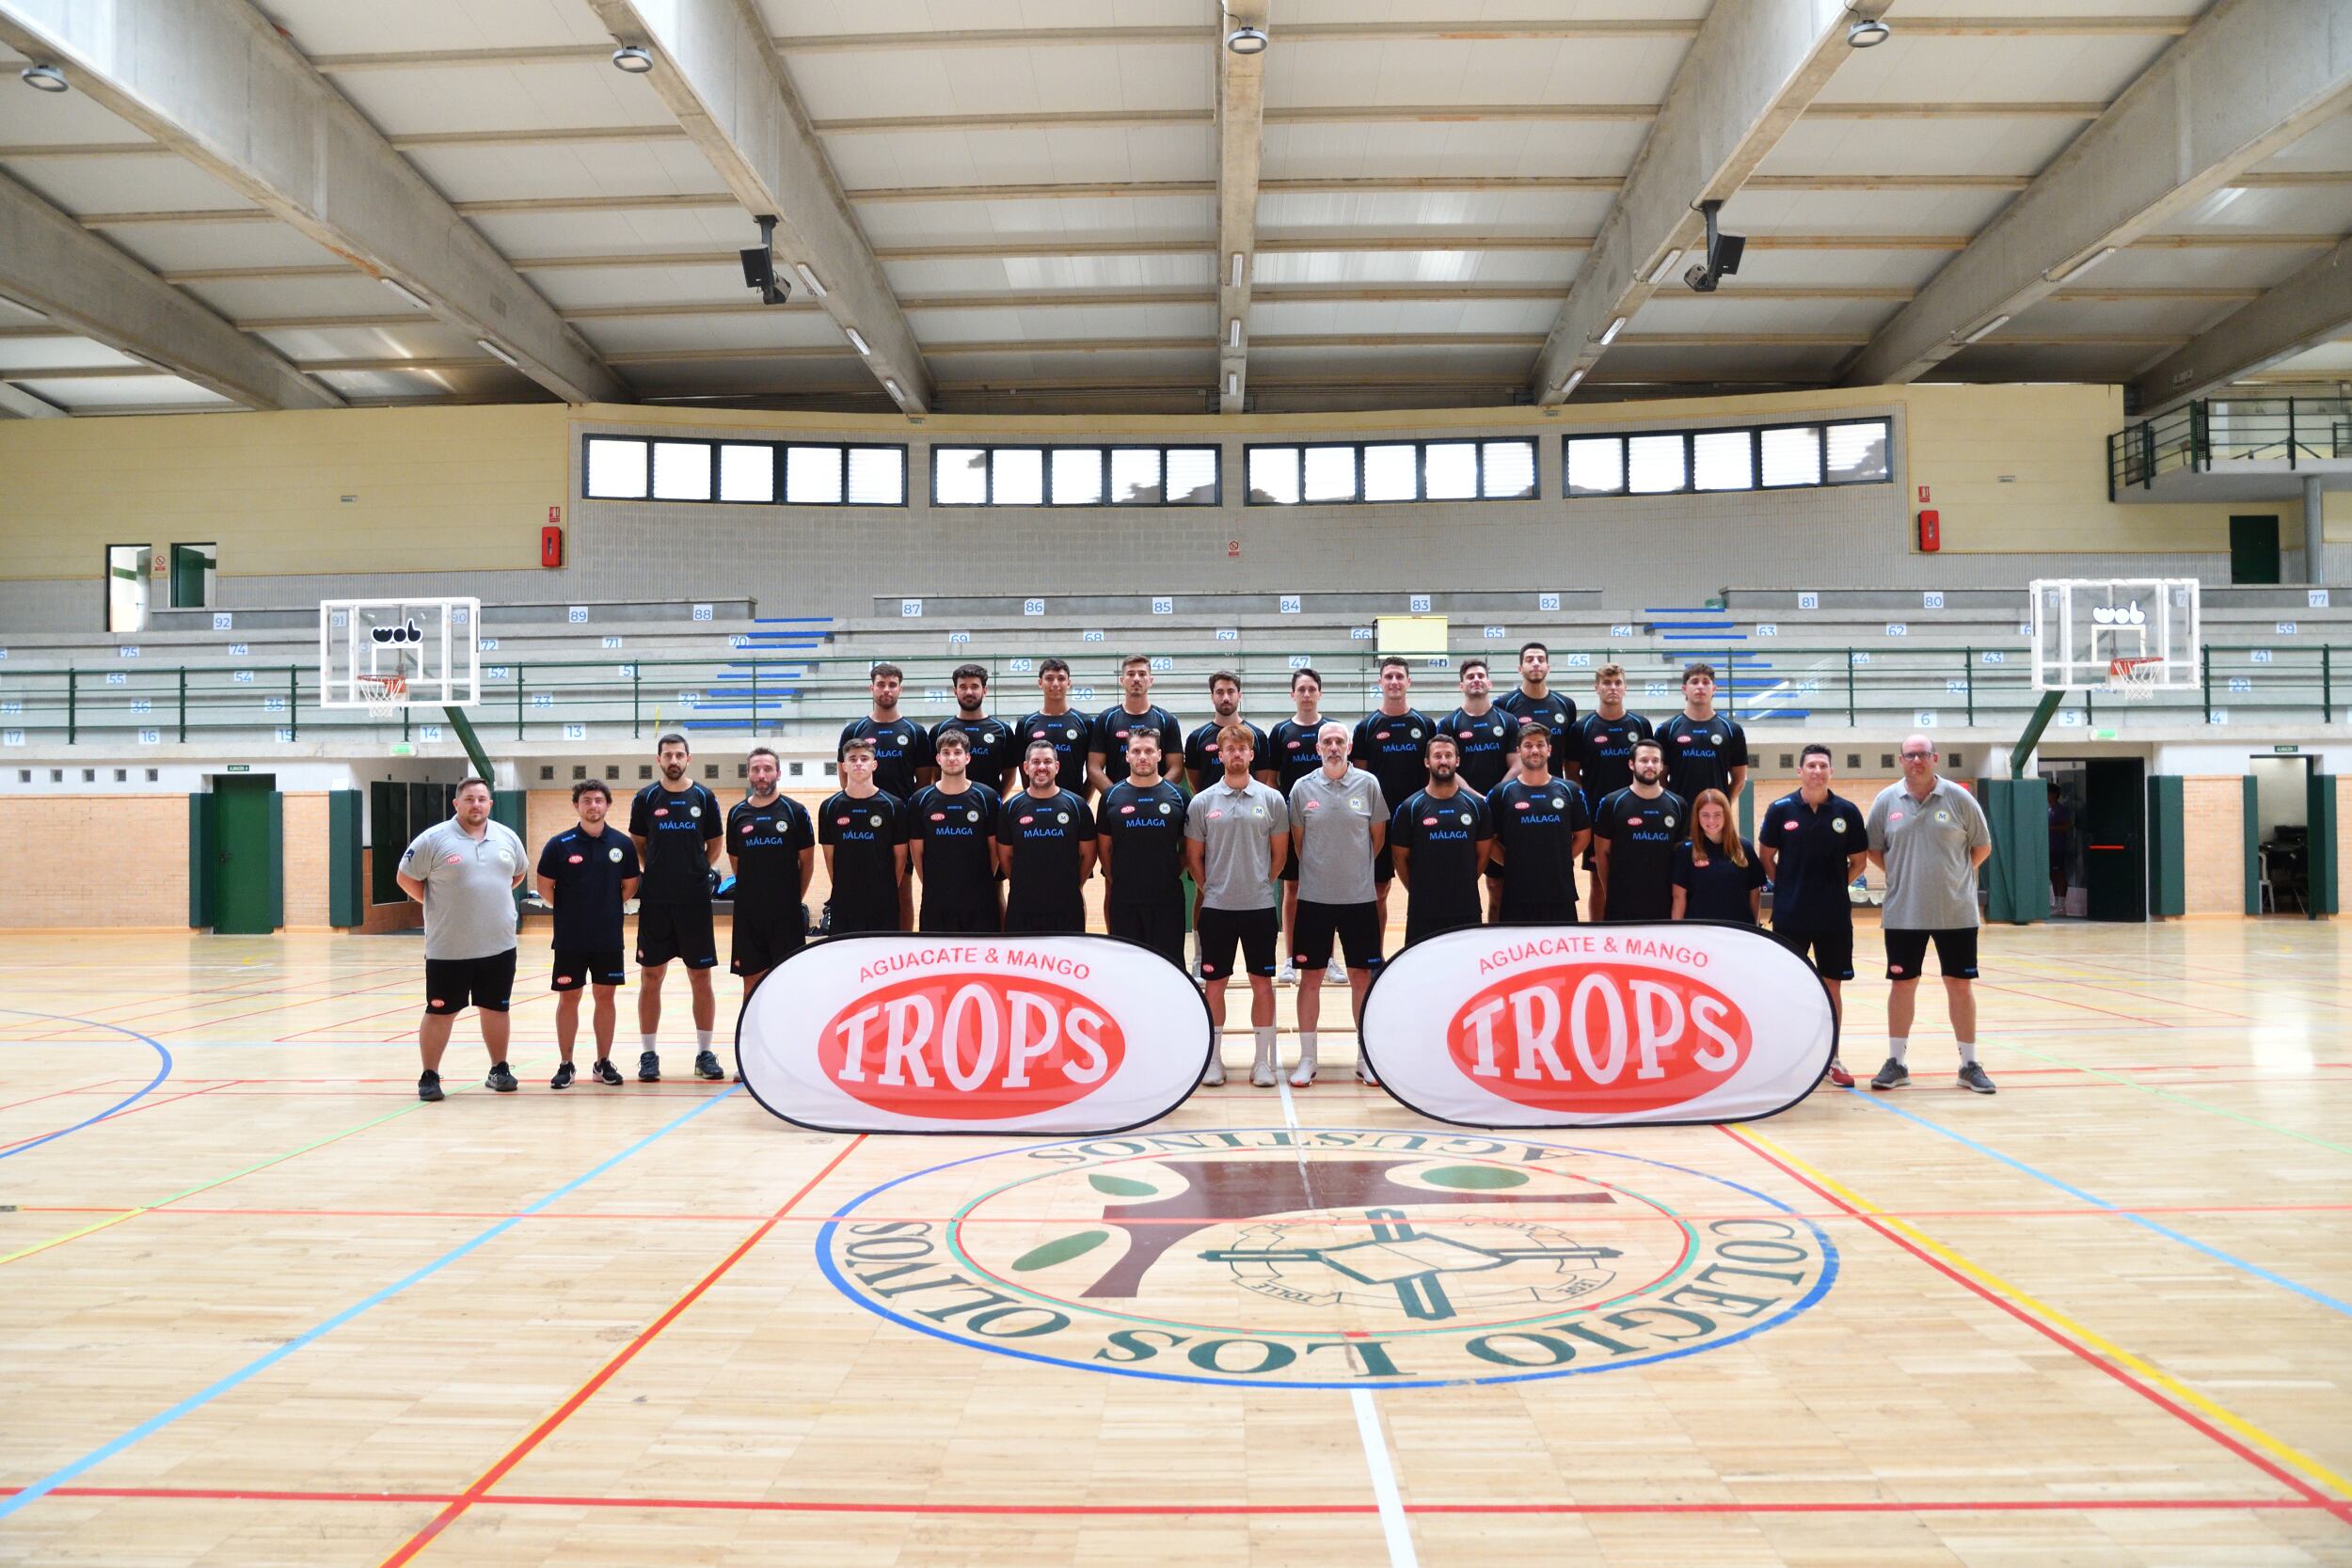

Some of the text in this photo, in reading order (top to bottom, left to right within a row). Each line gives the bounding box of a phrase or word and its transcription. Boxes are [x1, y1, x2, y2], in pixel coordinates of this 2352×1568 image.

[1542, 598, 1557, 609] 82
[1802, 597, 1815, 607] 81
[1925, 596, 1942, 607] 80
[2311, 594, 2327, 604] 77
[904, 604, 920, 614] 87
[1026, 602, 1043, 612] 86
[1154, 602, 1171, 612] 85
[1281, 601, 1299, 611] 84
[1413, 600, 1428, 610] 83
[571, 611, 586, 621] 89
[695, 610, 710, 619] 88
[215, 618, 230, 628] 92
[1353, 630, 1370, 639] 66
[1486, 628, 1503, 638] 65
[1613, 627, 1630, 636] 64
[1758, 626, 1775, 636] 63
[1888, 626, 1904, 636] 62
[2278, 625, 2295, 634] 59
[731, 637, 747, 646] 70
[1085, 633, 1102, 641] 68
[1219, 632, 1235, 640] 67
[482, 641, 496, 650] 72
[605, 639, 619, 648] 71
[122, 648, 137, 657] 75
[231, 645, 246, 655] 74
[1570, 656, 1588, 666] 45
[1984, 652, 2002, 662] 43
[2255, 651, 2269, 662] 41
[1012, 660, 1030, 671] 49
[1152, 659, 1171, 669] 48
[1290, 657, 1309, 668] 47
[236, 673, 251, 682] 54
[492, 668, 506, 678] 52
[110, 674, 124, 684] 55
[2232, 681, 2248, 692] 22
[681, 694, 698, 705] 32
[1074, 689, 1093, 699] 30
[266, 700, 282, 710] 35
[534, 696, 551, 707] 33
[133, 702, 149, 713] 36
[1921, 713, 1930, 725] 6
[2066, 712, 2074, 724] 5
[2212, 713, 2221, 724] 4
[8, 731, 21, 743] 17
[143, 730, 157, 741] 16
[280, 730, 293, 741] 15
[423, 727, 439, 738] 14
[567, 726, 582, 737] 13
[1383, 741, 1417, 752] MÁLAGA
[1465, 742, 1500, 753] MÁLAGA
[1600, 746, 1630, 757] MÁLAG
[1683, 748, 1716, 758] MÁLAGA
[1126, 817, 1166, 828] MÁLAGA
[1521, 813, 1560, 824] MÁLAGA
[659, 819, 696, 830] MÁLAGA
[936, 825, 973, 836] MÁLAGA
[1024, 827, 1064, 839] MÁLAGA
[1429, 829, 1468, 841] MÁLAGA
[1633, 830, 1669, 841] MÁLAGA
[746, 835, 783, 847] MÁLAGA
[1479, 936, 1709, 974] AGUACATE & MANGO
[860, 947, 1090, 983] AGUACATE & MANGO
[1462, 973, 1739, 1085] TROPS
[835, 983, 1109, 1092] TROPS
[1027, 1132, 1585, 1164] AGUSTINOS
[845, 1219, 1808, 1377] COLEGIO LOS OLIVOS
